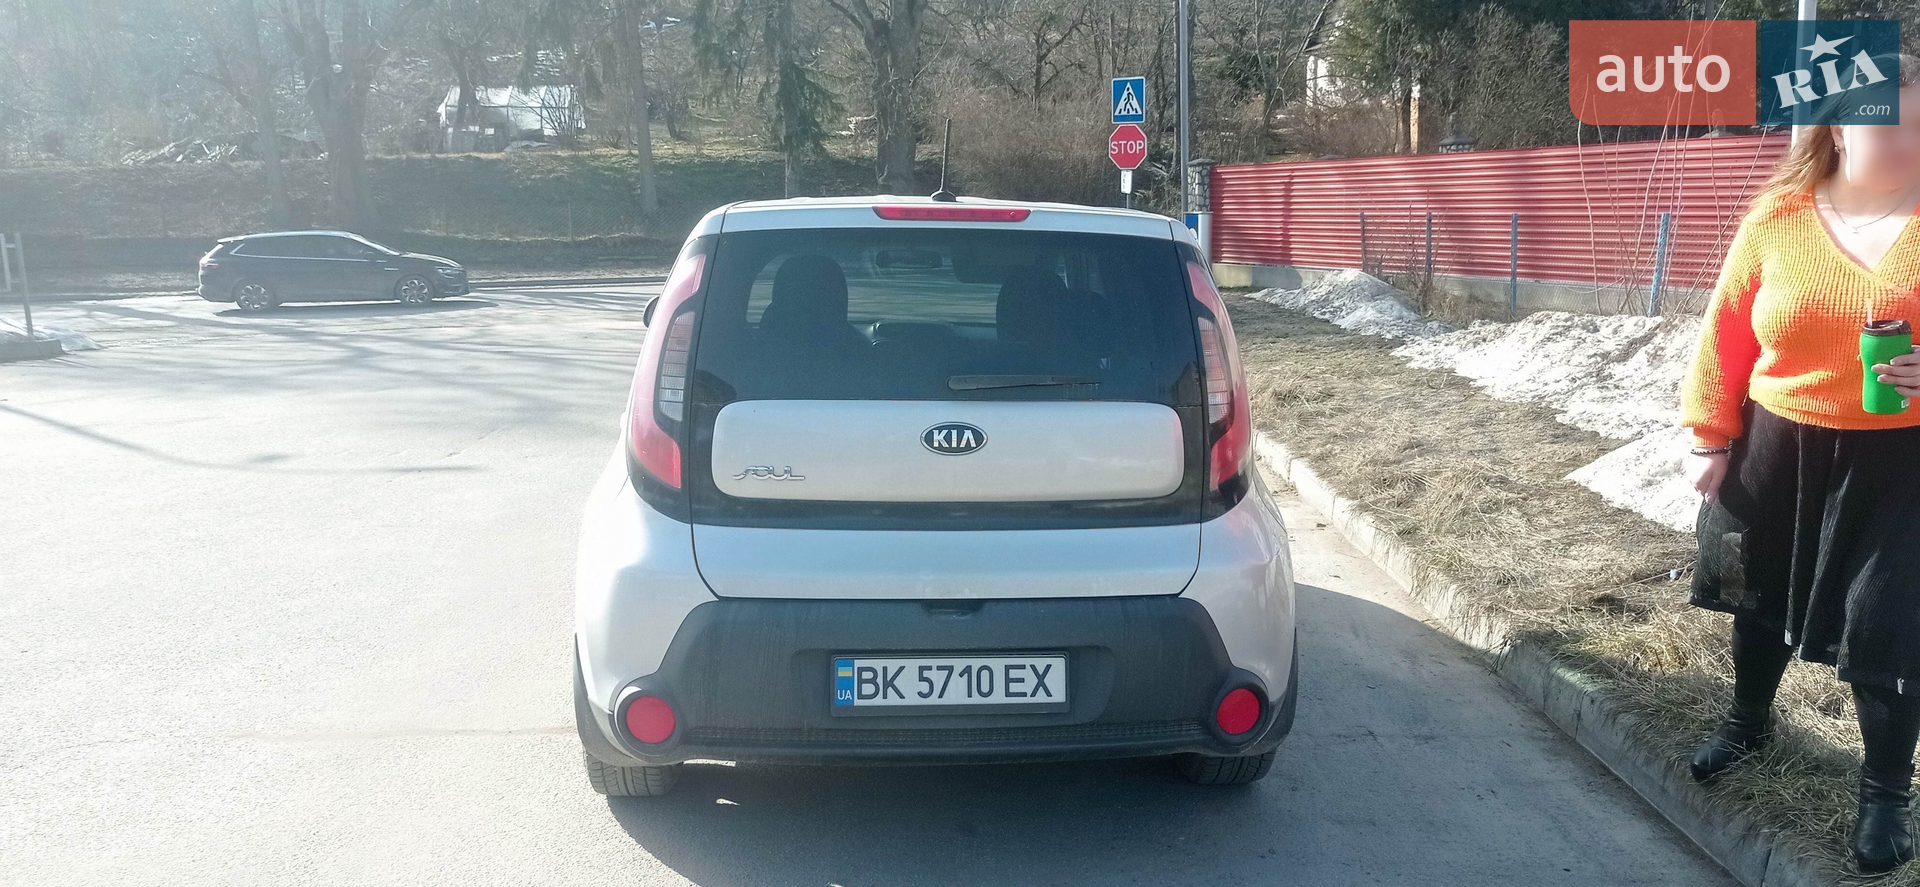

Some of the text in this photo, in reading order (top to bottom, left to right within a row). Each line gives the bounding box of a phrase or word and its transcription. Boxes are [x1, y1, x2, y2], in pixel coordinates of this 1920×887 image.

[1110, 140, 1145, 155] STOP
[932, 429, 977, 448] KIA
[857, 664, 1053, 700] BK 5710 EX
[837, 689, 853, 700] UA
